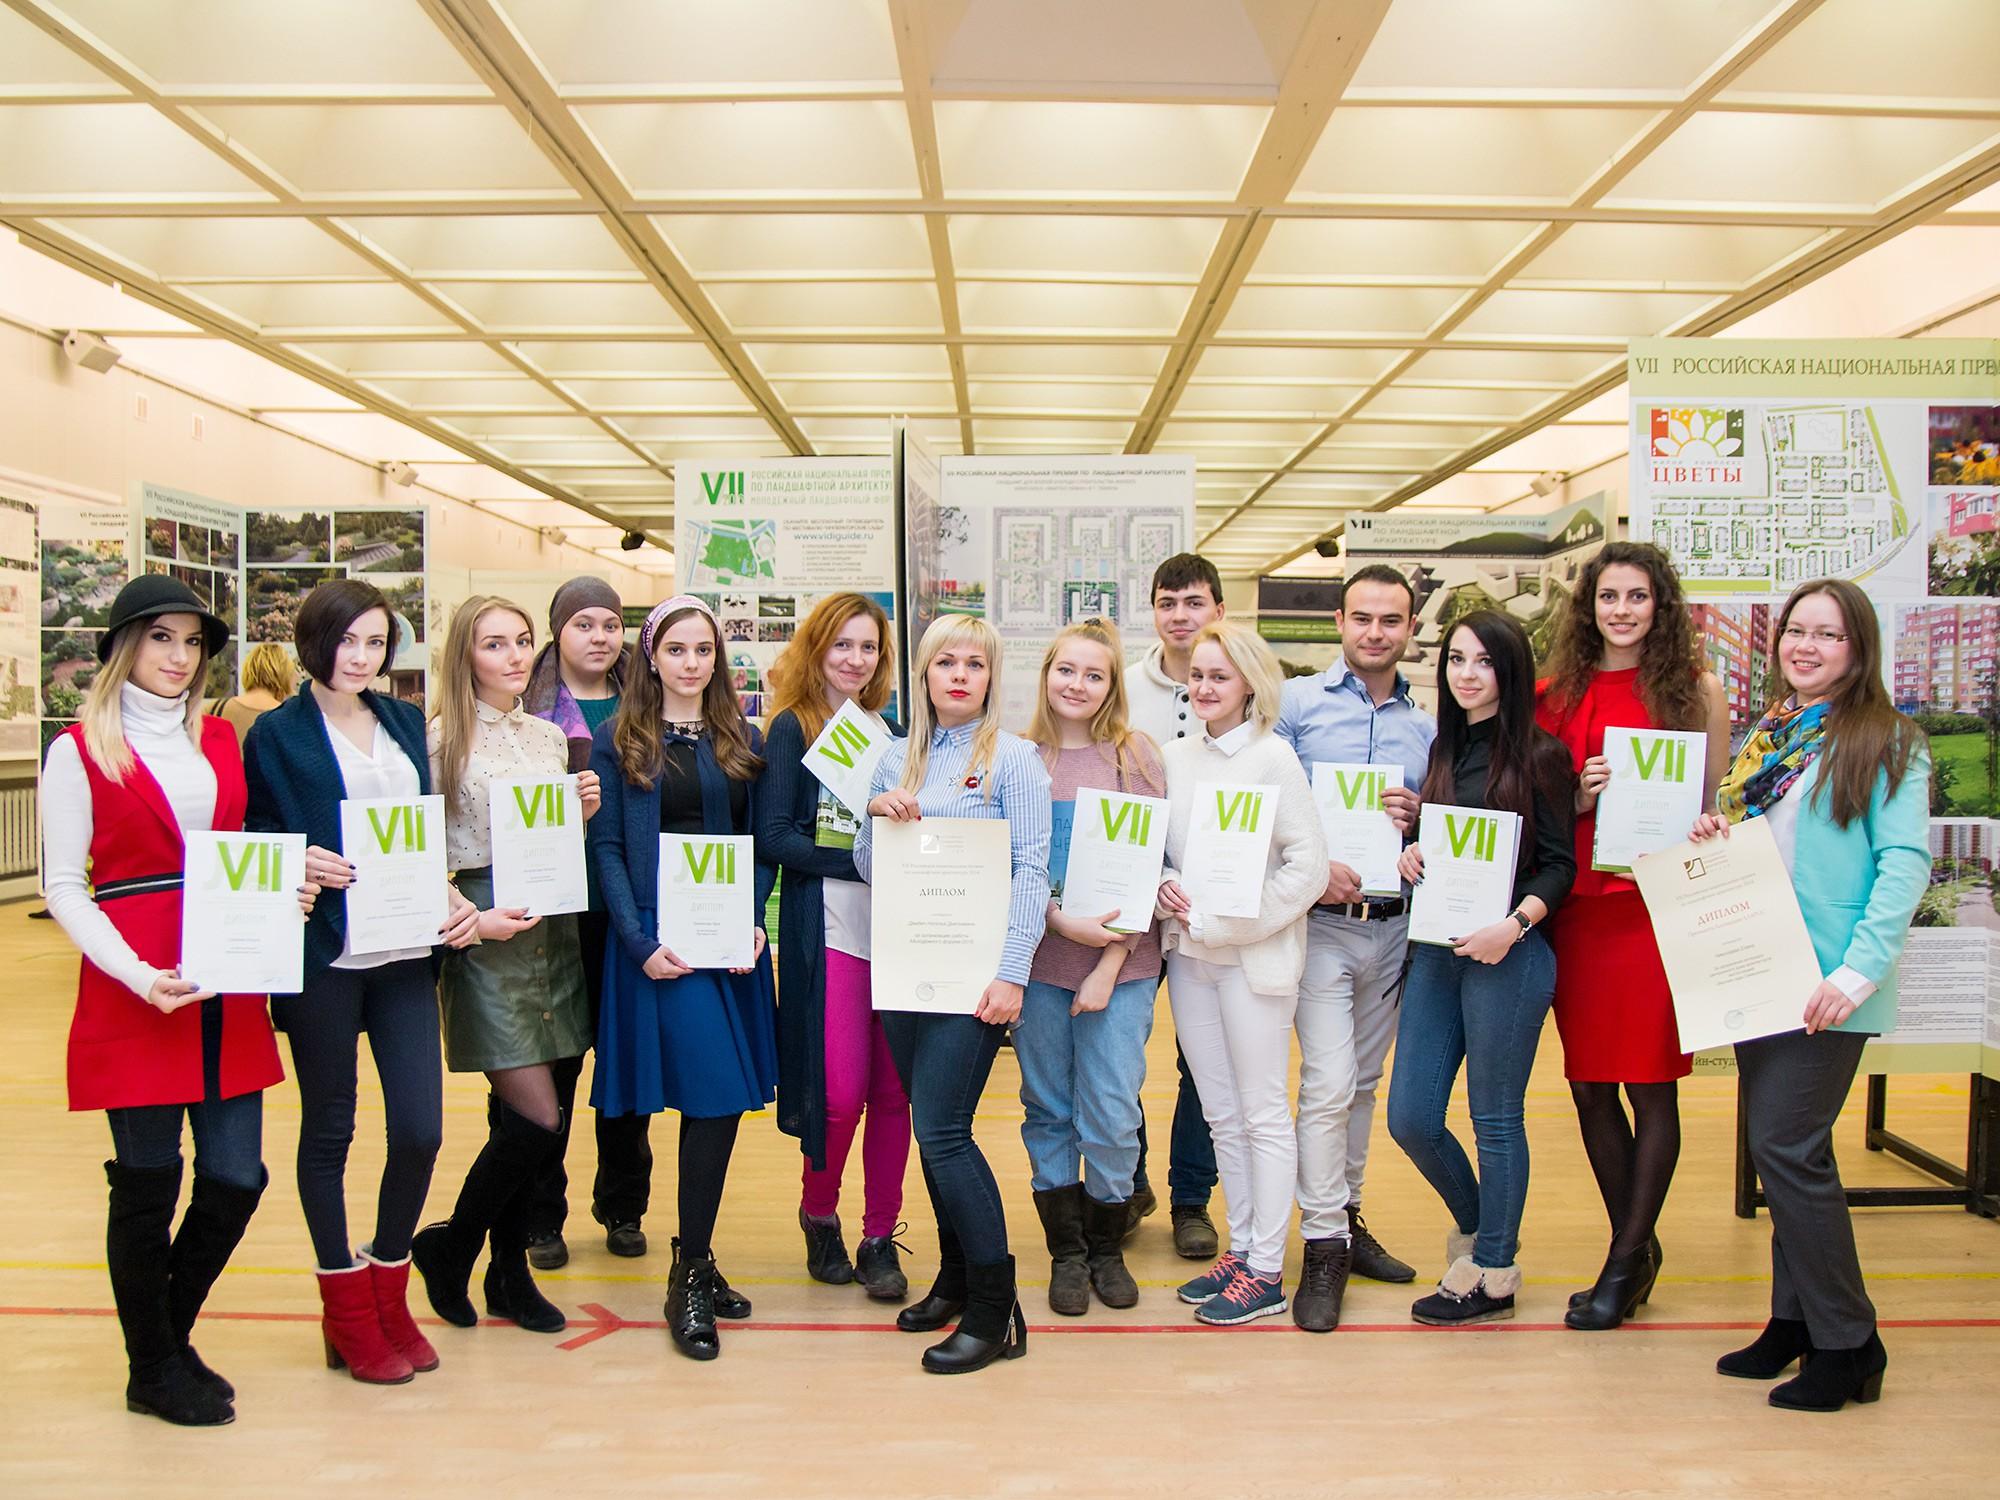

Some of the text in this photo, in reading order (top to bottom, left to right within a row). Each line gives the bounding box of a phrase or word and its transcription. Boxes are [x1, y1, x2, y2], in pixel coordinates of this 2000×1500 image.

[1636, 358, 1659, 374] VII
[1672, 356, 1796, 375] РОССИЙСКАЯ
[1800, 358, 1955, 377] НАЦИОНАЛЬНАЯ
[700, 471, 745, 505] VII
[751, 468, 803, 479] РОССИЙСКАЯ
[804, 468, 868, 480] НАЦИОНАЛЬНАЯ
[751, 482, 762, 491] ПО
[766, 480, 836, 492] ЛАНДШАФТНОЙ
[1653, 467, 1743, 486] ЦВЕТЫ
[809, 495, 871, 505] ЛАНДШАФТНЫЙ
[793, 532, 874, 542] www.vidiguide.ru
[1350, 519, 1372, 530] VII
[1440, 519, 1517, 528] НАЦИОНАЛЬНАЯ
[1390, 527, 1460, 536] ЛАНДШАФТНОЙ
[817, 715, 872, 769] VII
[1629, 736, 1687, 783] VII
[512, 783, 566, 829] VII
[1100, 798, 1152, 847] VII
[1216, 790, 1263, 833] VII
[366, 804, 426, 854] VII
[1444, 813, 1498, 862] VII
[217, 841, 283, 892] VII
[682, 841, 736, 885] VII
[919, 888, 966, 897] ДИПЛОМ
[1697, 900, 1751, 926] ДИПЛОМ
